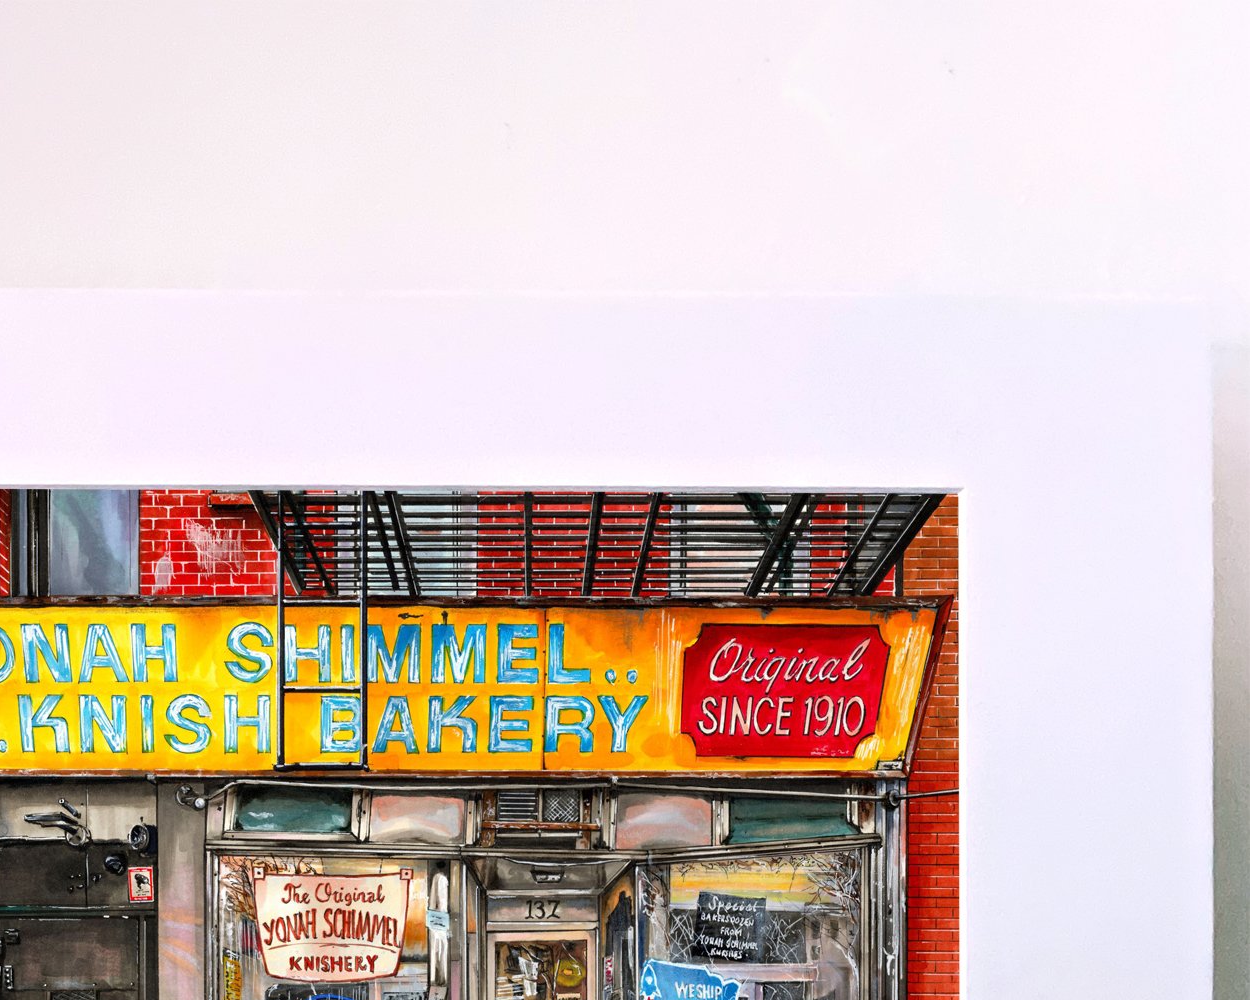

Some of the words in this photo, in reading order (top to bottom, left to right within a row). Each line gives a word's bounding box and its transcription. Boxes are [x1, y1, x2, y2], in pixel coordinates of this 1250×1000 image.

[707, 635, 870, 696] Original
[320, 694, 649, 754] BAKERY
[697, 696, 792, 738] SINCE
[804, 695, 866, 738] 1910
[281, 883, 310, 904] The
[314, 882, 386, 906] Original
[262, 908, 318, 946] YONAH
[322, 908, 400, 949] SCHIMMEL
[720, 926, 743, 937] FROM
[289, 954, 379, 974] KNISHERY
